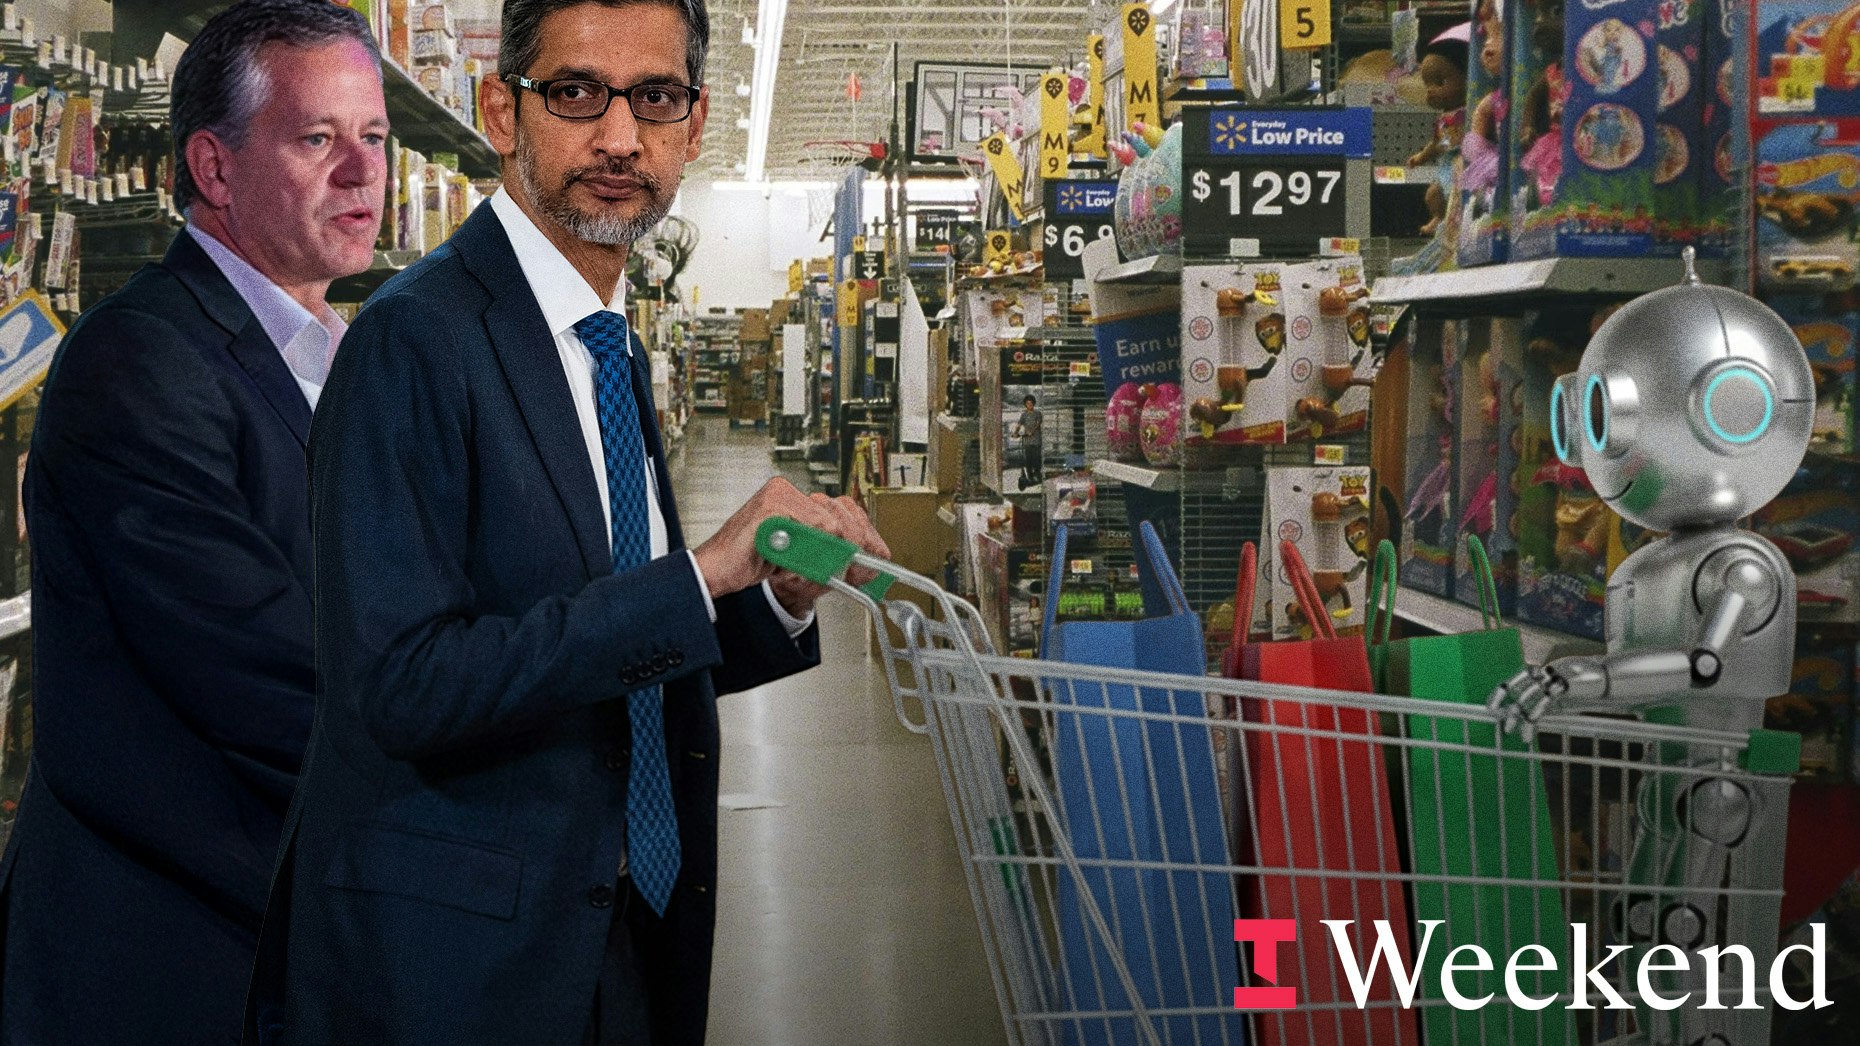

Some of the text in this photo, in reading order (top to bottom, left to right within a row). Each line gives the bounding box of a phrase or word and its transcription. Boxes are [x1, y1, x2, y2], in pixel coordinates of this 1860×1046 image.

[1296, 7, 1315, 38] 5
[1130, 80, 1152, 104] M
[1252, 120, 1286, 131] Everyday
[1044, 132, 1064, 150] M
[1252, 127, 1345, 145] Low Price
[1048, 157, 1059, 173] 9
[1086, 198, 1114, 207] Low
[1116, 338, 1161, 357] Earn
